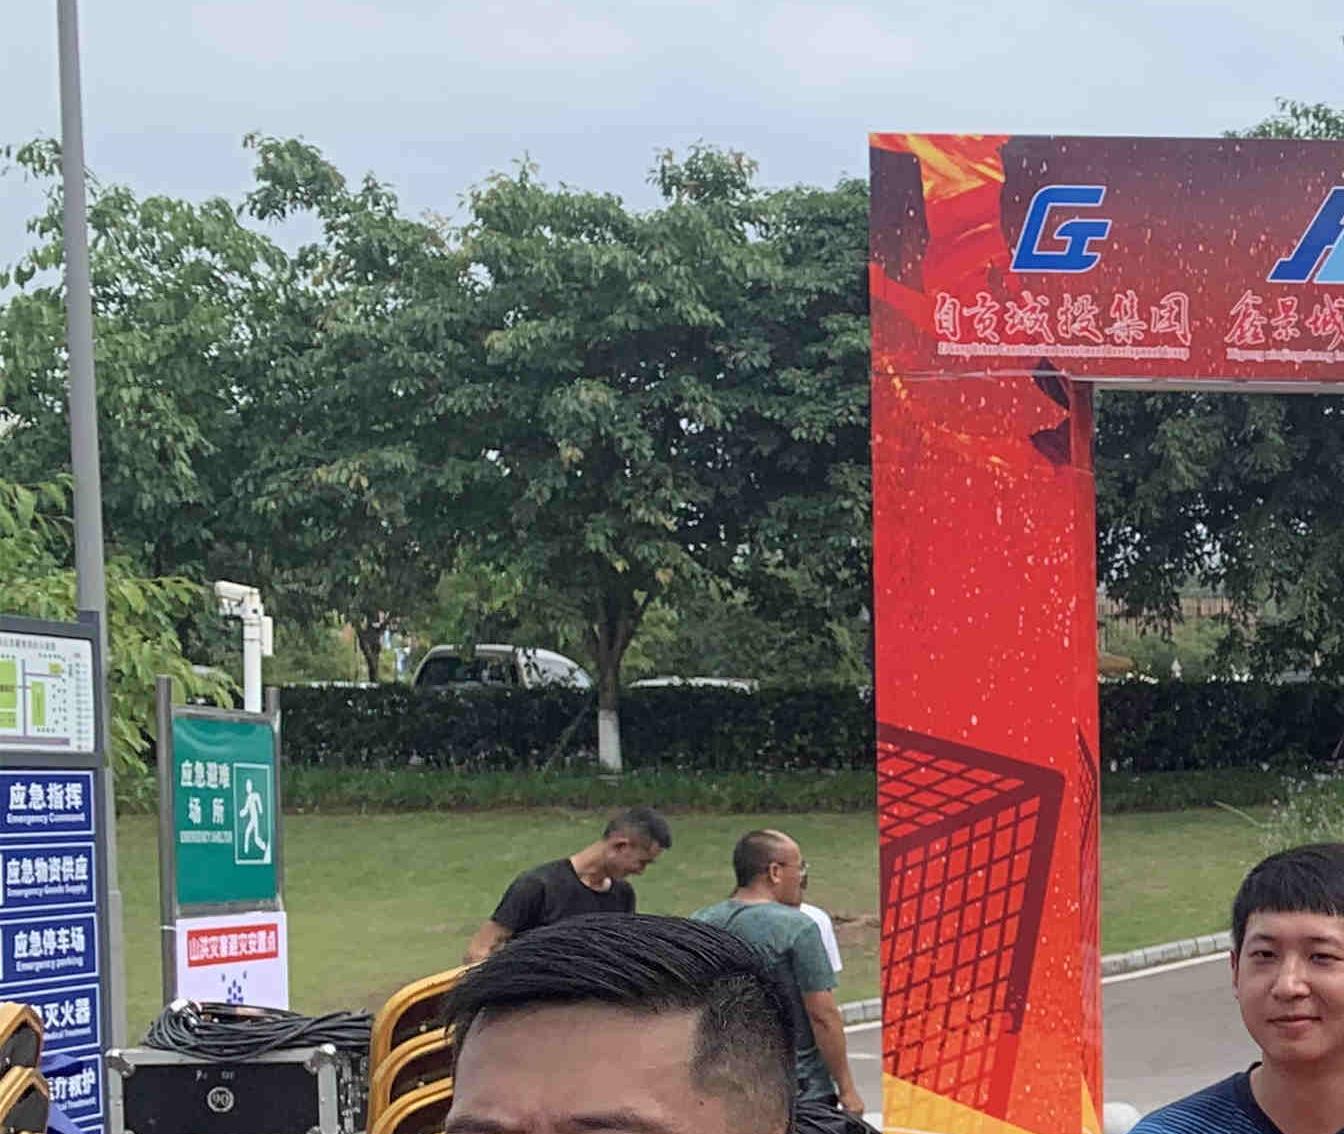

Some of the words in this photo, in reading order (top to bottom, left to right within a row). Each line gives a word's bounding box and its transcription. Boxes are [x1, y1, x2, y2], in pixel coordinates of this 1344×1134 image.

[9, 782, 83, 810] 应急指挥
[6, 854, 88, 885] 应急物资供应
[14, 926, 85, 958] 应急停车场
